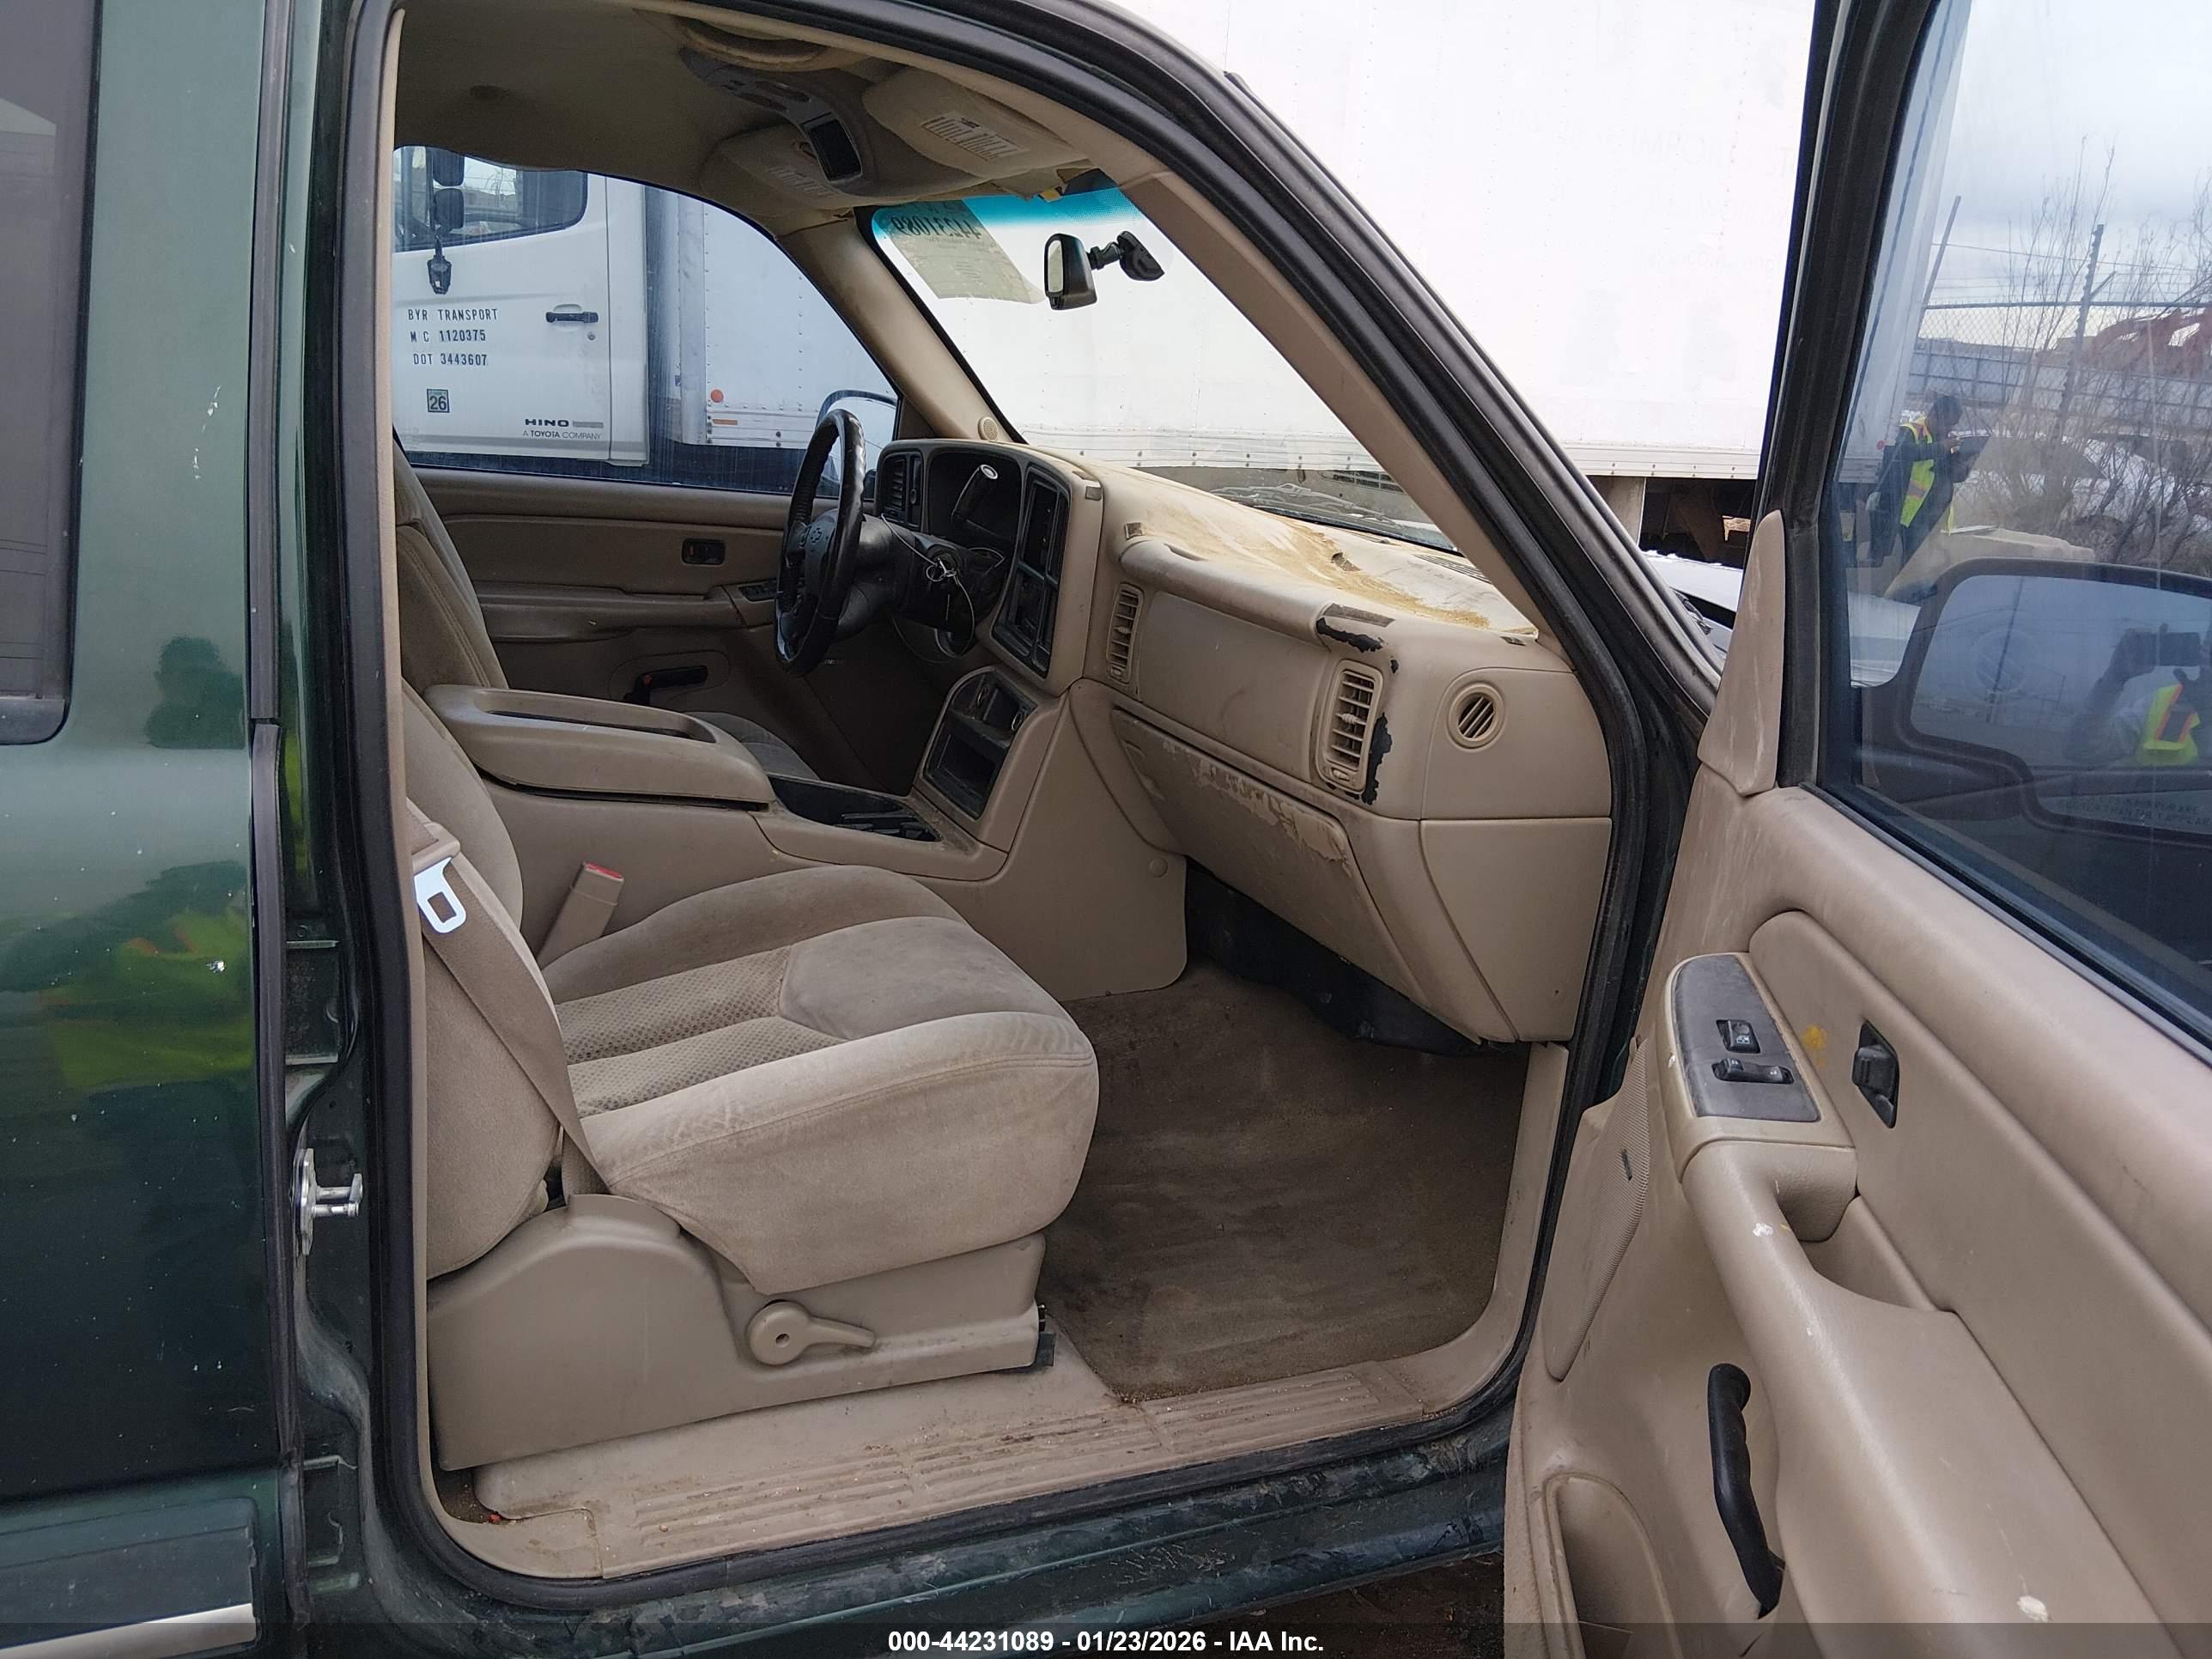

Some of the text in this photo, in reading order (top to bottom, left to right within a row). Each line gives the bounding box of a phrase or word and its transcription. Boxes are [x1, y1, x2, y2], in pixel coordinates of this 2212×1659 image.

[408, 308, 498, 321] BYR TRANSPORT
[439, 330, 486, 342] 1120375
[413, 353, 488, 366] DOT 3443607
[429, 395, 447, 410] 26
[525, 418, 569, 428] HINO
[530, 430, 560, 439] TOYOTA
[562, 431, 601, 441] COMPANY
